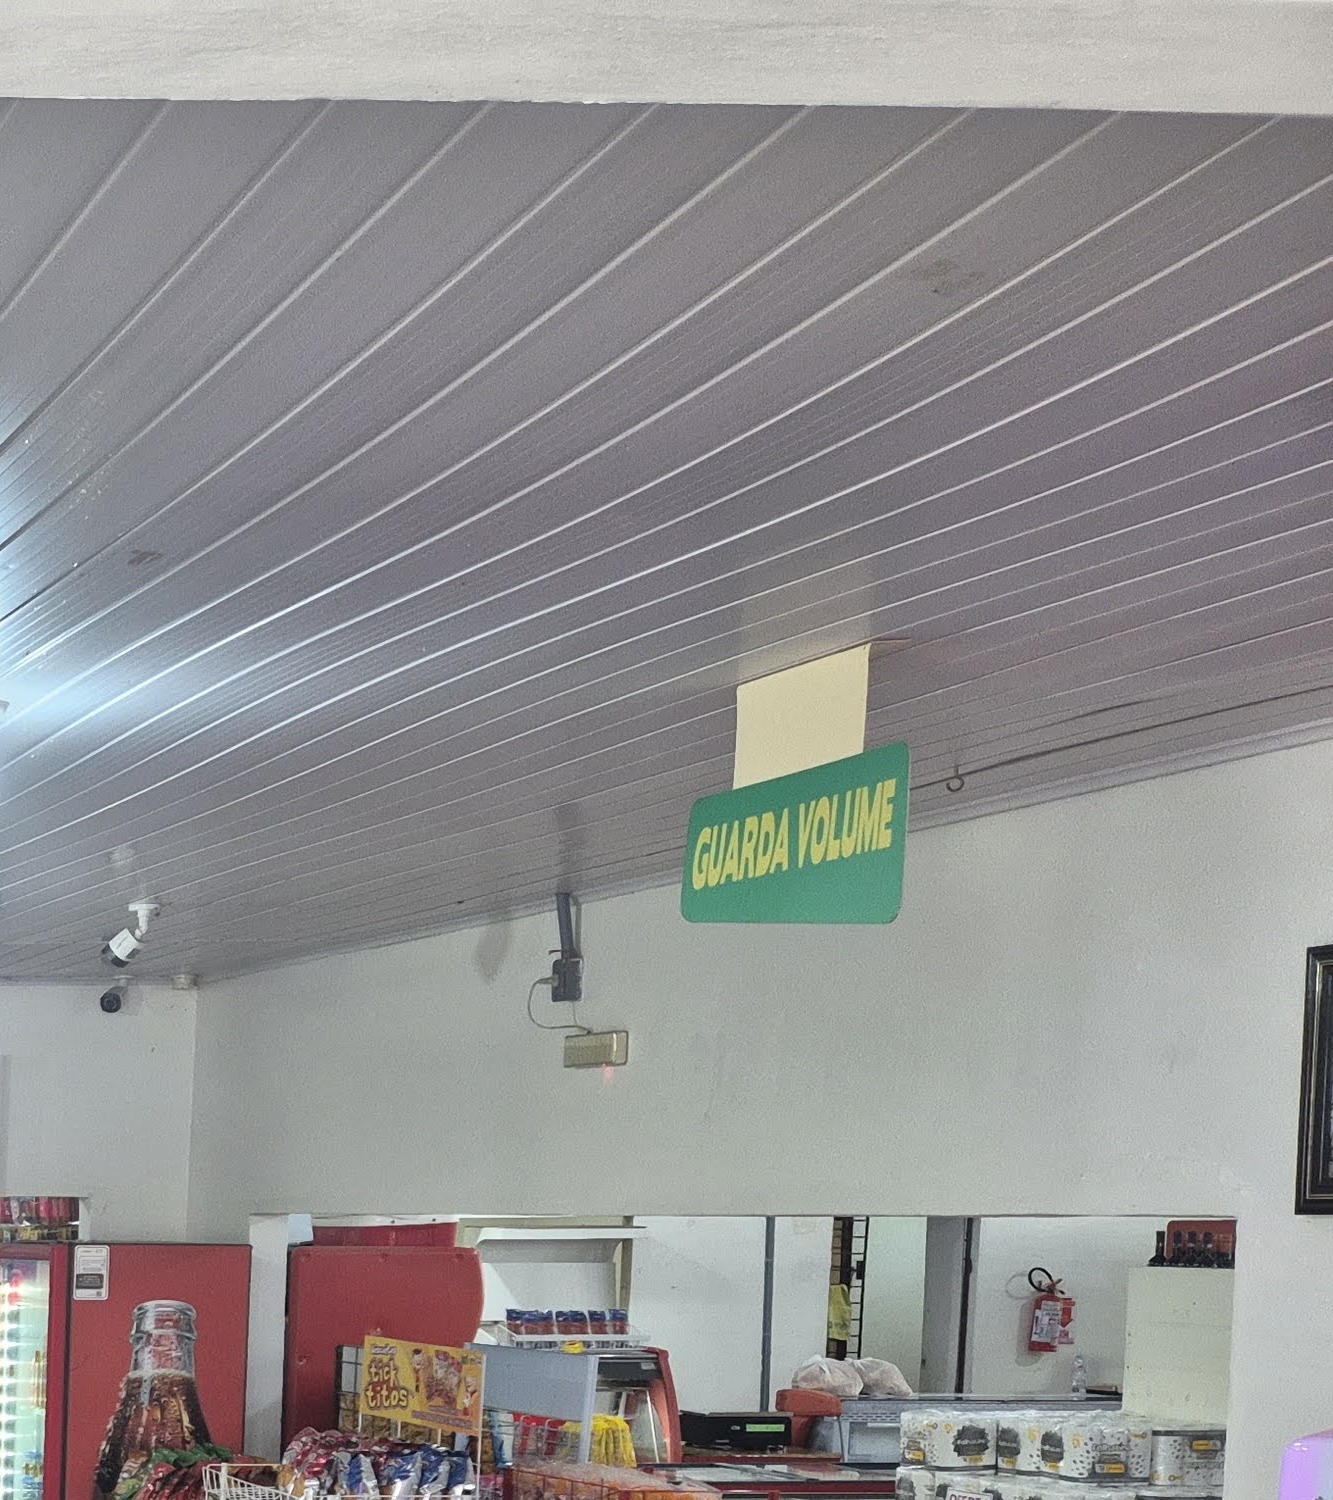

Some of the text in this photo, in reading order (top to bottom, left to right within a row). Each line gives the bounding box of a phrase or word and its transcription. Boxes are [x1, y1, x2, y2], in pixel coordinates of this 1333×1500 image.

[692, 778, 897, 890] GUARDA VOLUME
[370, 1360, 398, 1387] tick
[365, 1384, 408, 1408] titos
